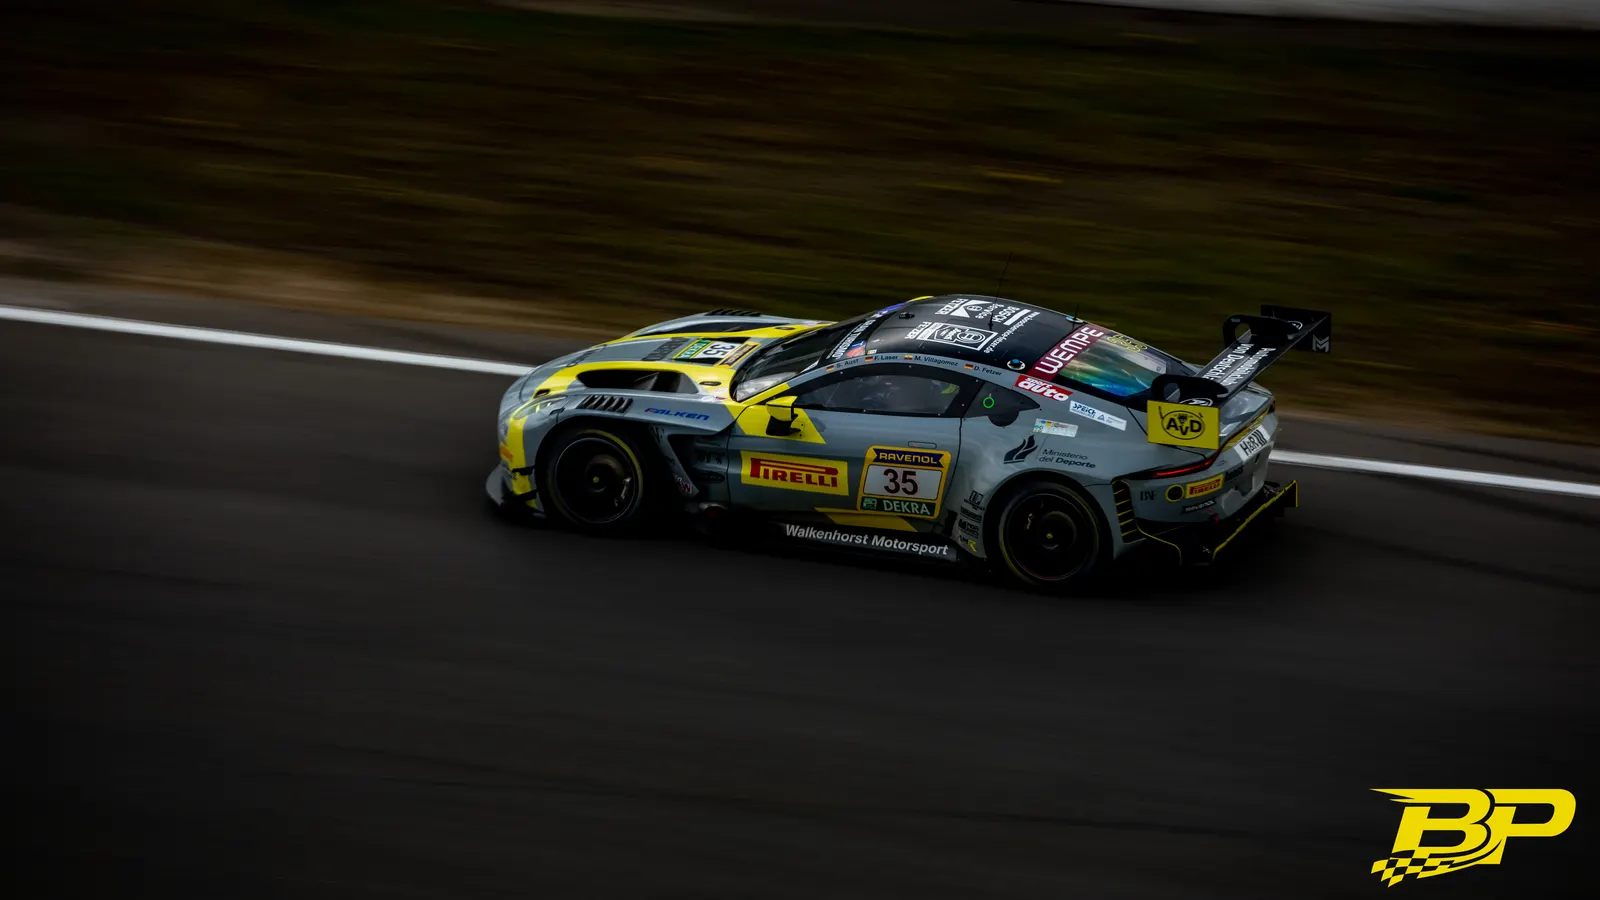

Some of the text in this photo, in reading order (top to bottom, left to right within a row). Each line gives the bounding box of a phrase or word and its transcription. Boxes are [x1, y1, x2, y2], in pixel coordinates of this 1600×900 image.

[991, 305, 1021, 323] BOSCH
[702, 344, 734, 356] 35
[1038, 325, 1105, 376] WEMPE
[844, 358, 859, 366] Aust
[924, 356, 959, 367] Villagomez
[981, 366, 1003, 376] Fetzer
[1017, 380, 1069, 401] auto
[644, 407, 710, 421] FALKEN
[878, 452, 938, 466] RAVENOL
[1042, 448, 1088, 460] Ministerio
[1039, 455, 1096, 469] del Deporte
[750, 457, 839, 488] PIRELLI
[883, 468, 919, 496] 35
[1189, 478, 1221, 495] PIRELLI
[882, 498, 931, 516] DEKRA
[785, 523, 870, 545] Walkenhorst
[871, 534, 949, 556] Motorsport
